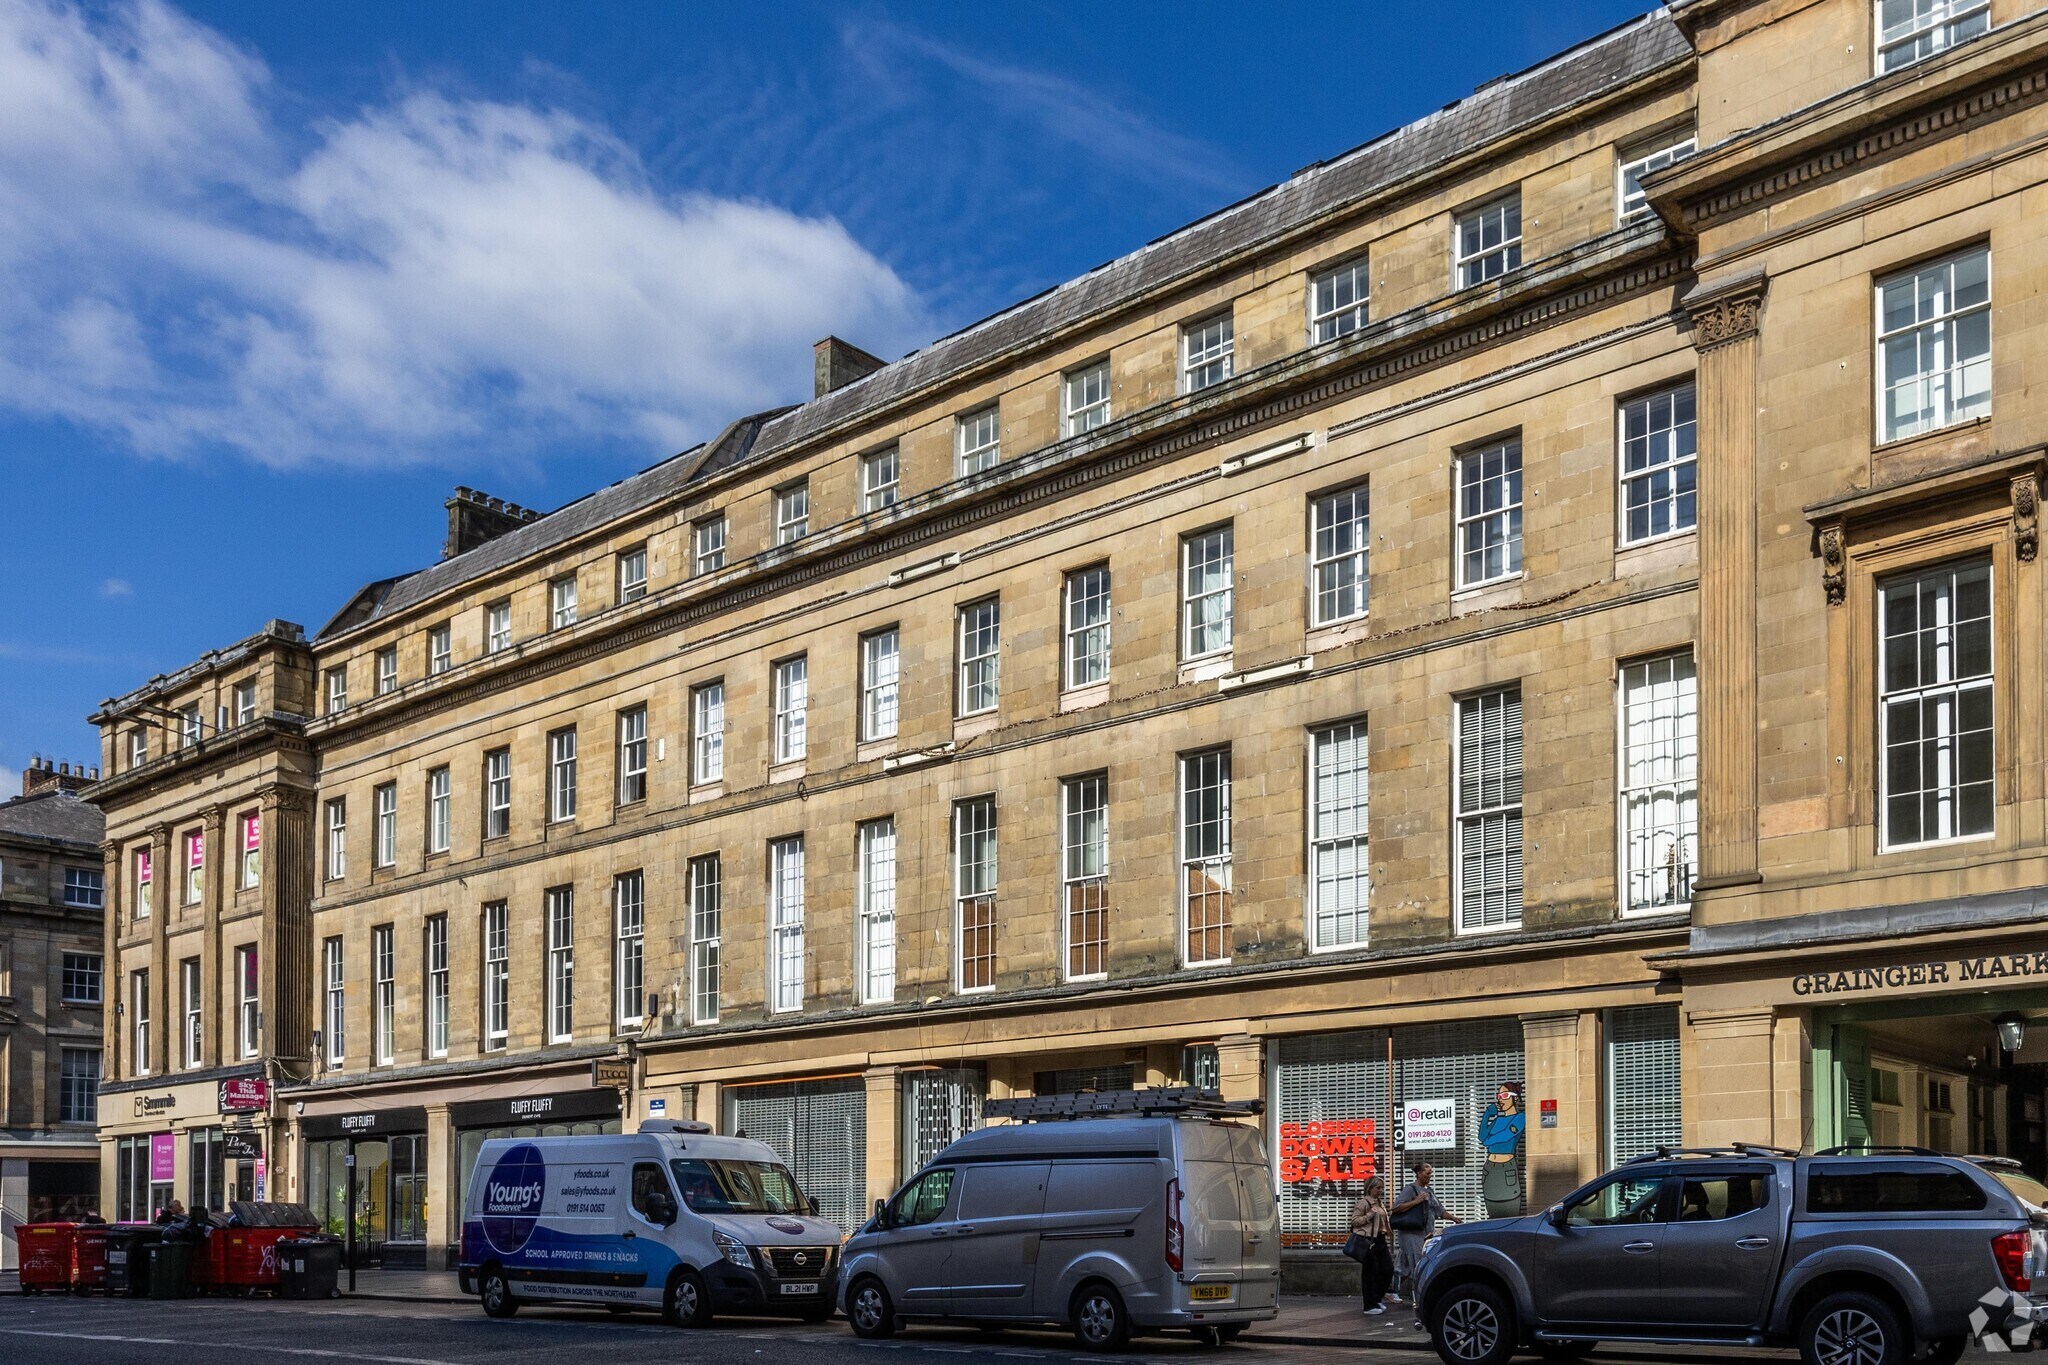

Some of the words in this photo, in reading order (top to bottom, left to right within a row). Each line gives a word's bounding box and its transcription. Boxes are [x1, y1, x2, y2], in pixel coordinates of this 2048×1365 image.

[1792, 961, 1950, 996] GRAINGER
[1959, 952, 2048, 981] MARK
[600, 1069, 628, 1079] TUCCI
[229, 1093, 265, 1101] Massage
[511, 1100, 531, 1114] FLUFFY
[532, 1098, 553, 1112] FLUFFY
[342, 1116, 358, 1128] FLUFFY
[359, 1114, 376, 1127] FLUFFY
[1393, 1106, 1404, 1127] LET
[1407, 1106, 1452, 1122] @retail
[1280, 1118, 1375, 1137] CLOSING
[1436, 1129, 1452, 1137] 4120
[1394, 1128, 1404, 1147] TO
[1280, 1136, 1375, 1157] DOWN
[573, 1169, 611, 1180] yfoods.co.uk
[1280, 1156, 1375, 1182] SALE
[489, 1181, 541, 1208] Young's
[560, 1185, 617, 1198] sales@yfoods.co.uk
[488, 1203, 522, 1212] Foodservice
[566, 1203, 579, 1213] 0191
[579, 1204, 589, 1213] 514
[525, 1249, 549, 1259] SCHOOL
[551, 1250, 582, 1260] APPROVED
[584, 1251, 607, 1261] DRINKS
[607, 1252, 612, 1261] &
[612, 1252, 639, 1262] SNACKS
[523, 1285, 537, 1293] FOOD
[538, 1285, 570, 1295] DISTRIBUTION
[571, 1288, 593, 1296] ACROSS
[593, 1288, 604, 1297] THE
